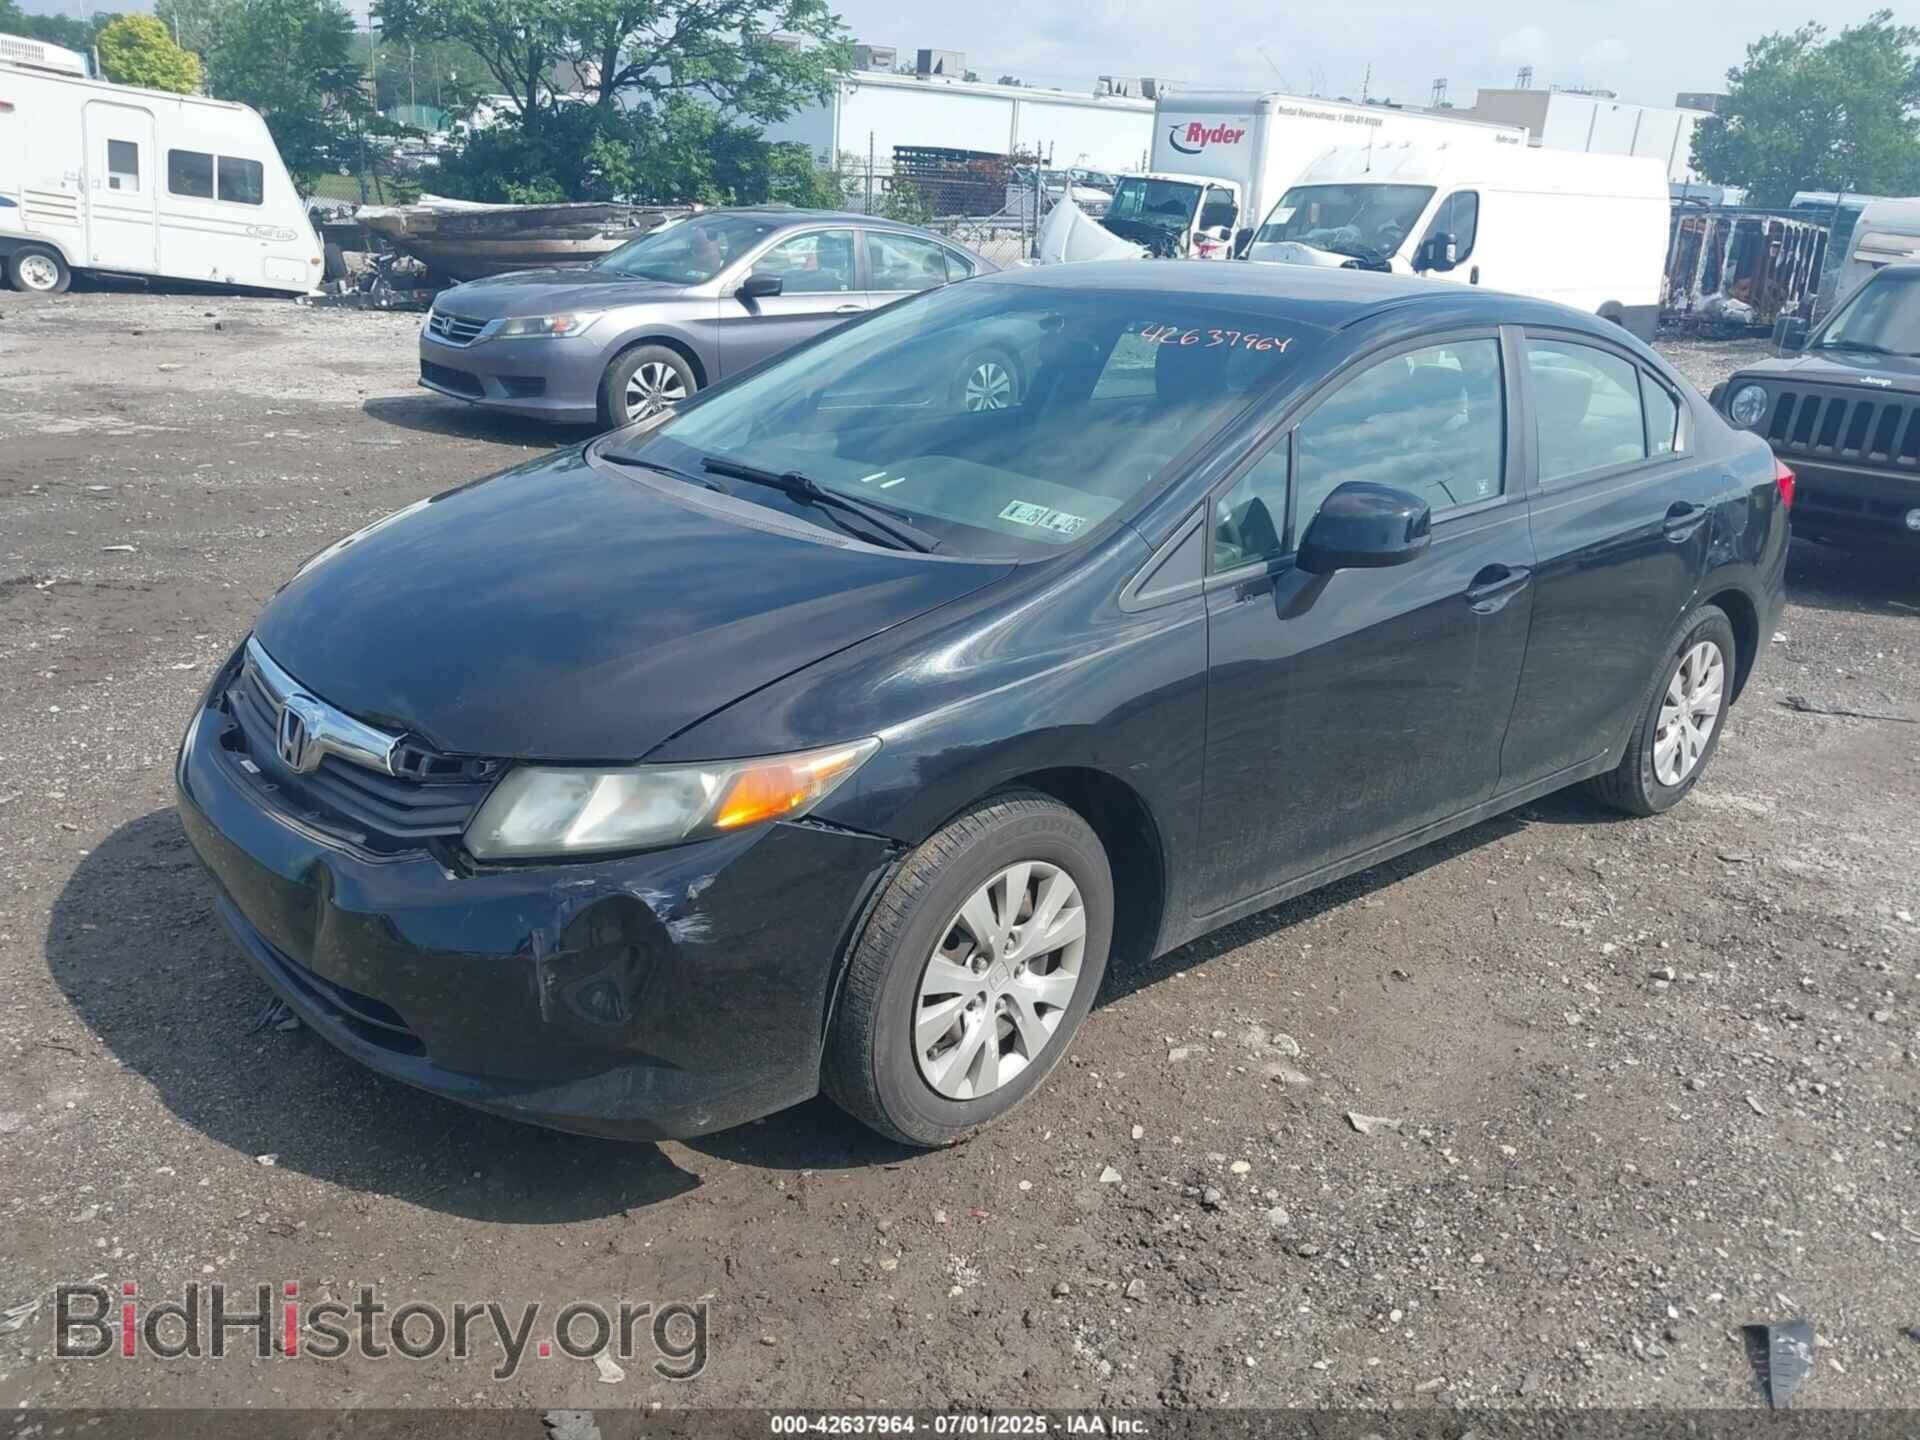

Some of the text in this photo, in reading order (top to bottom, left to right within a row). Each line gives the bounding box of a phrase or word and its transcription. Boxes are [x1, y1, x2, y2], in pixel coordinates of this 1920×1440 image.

[1185, 122, 1245, 147] Ryder
[1140, 325, 1293, 353] 42637964
[1860, 376, 1892, 387] Jeep
